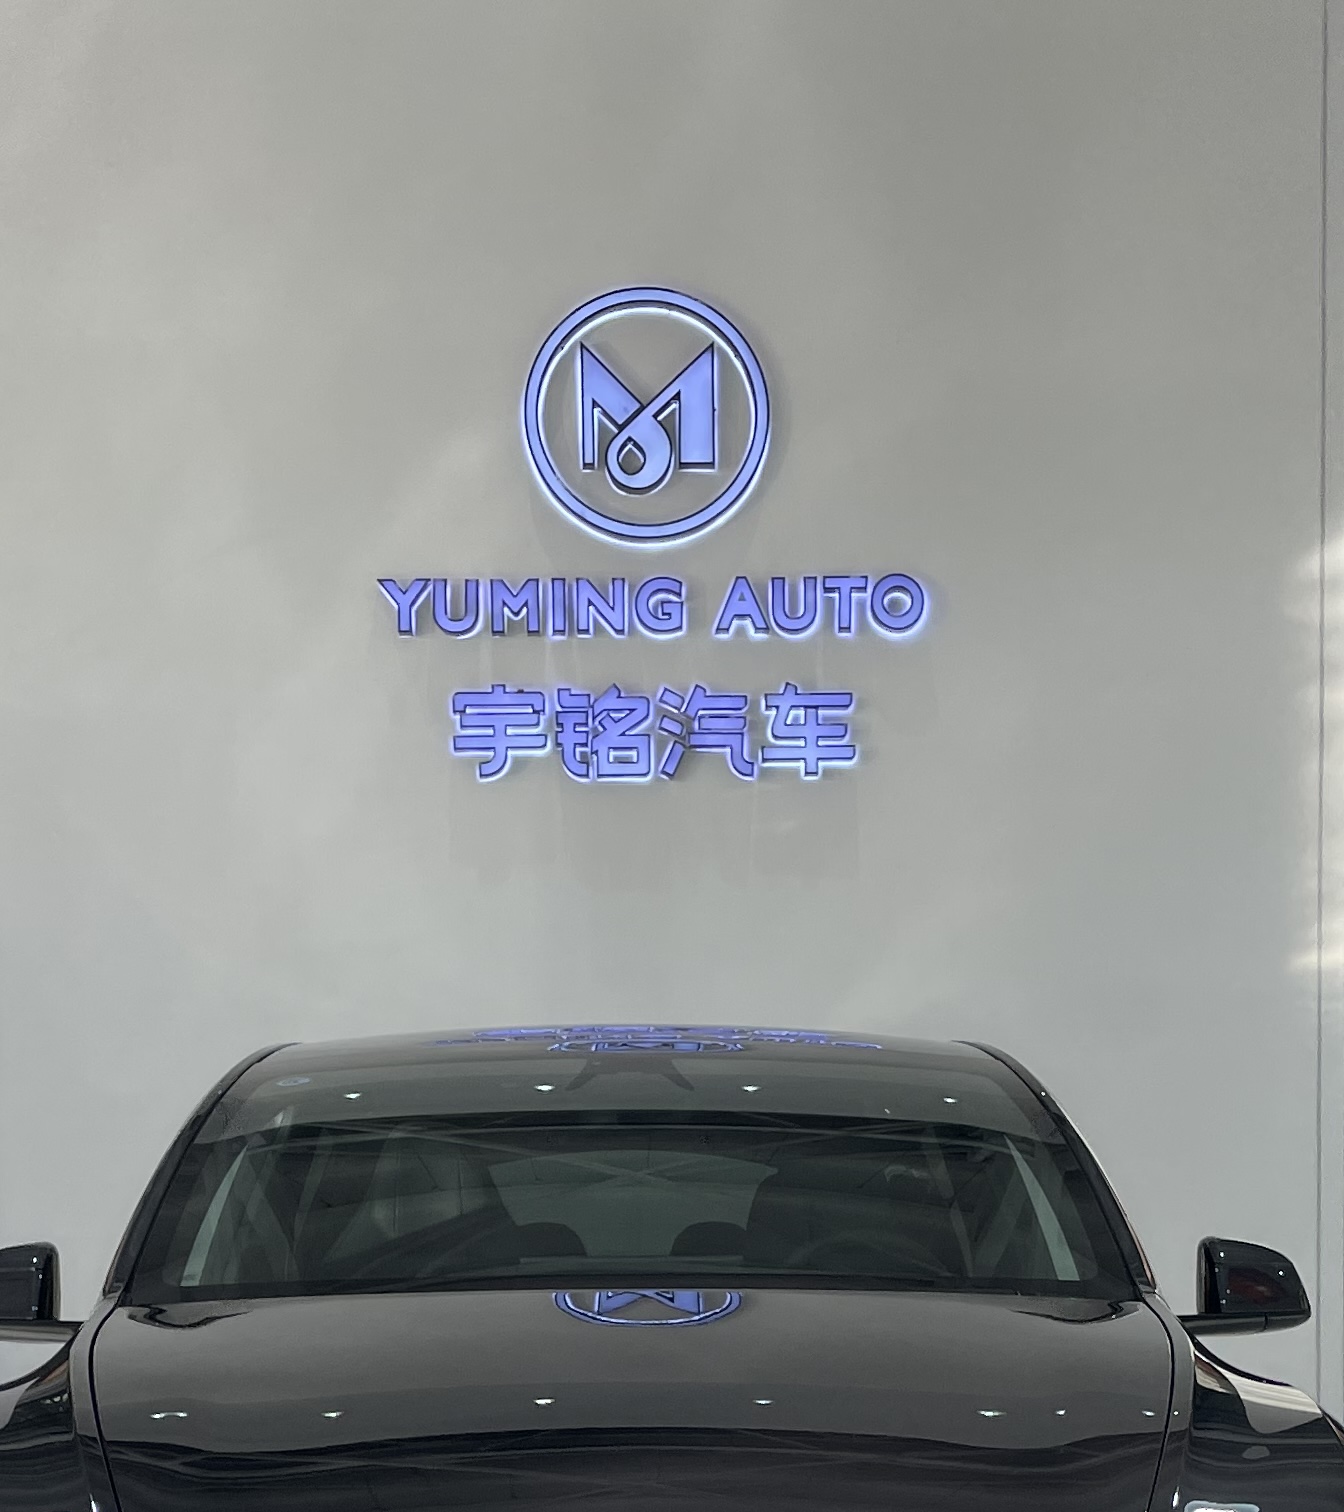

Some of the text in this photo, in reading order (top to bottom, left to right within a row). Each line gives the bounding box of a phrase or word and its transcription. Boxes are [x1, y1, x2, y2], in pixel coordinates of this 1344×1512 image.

[377, 573, 927, 637] YUMING AUTO
[452, 682, 858, 781] 宇铭汽车
